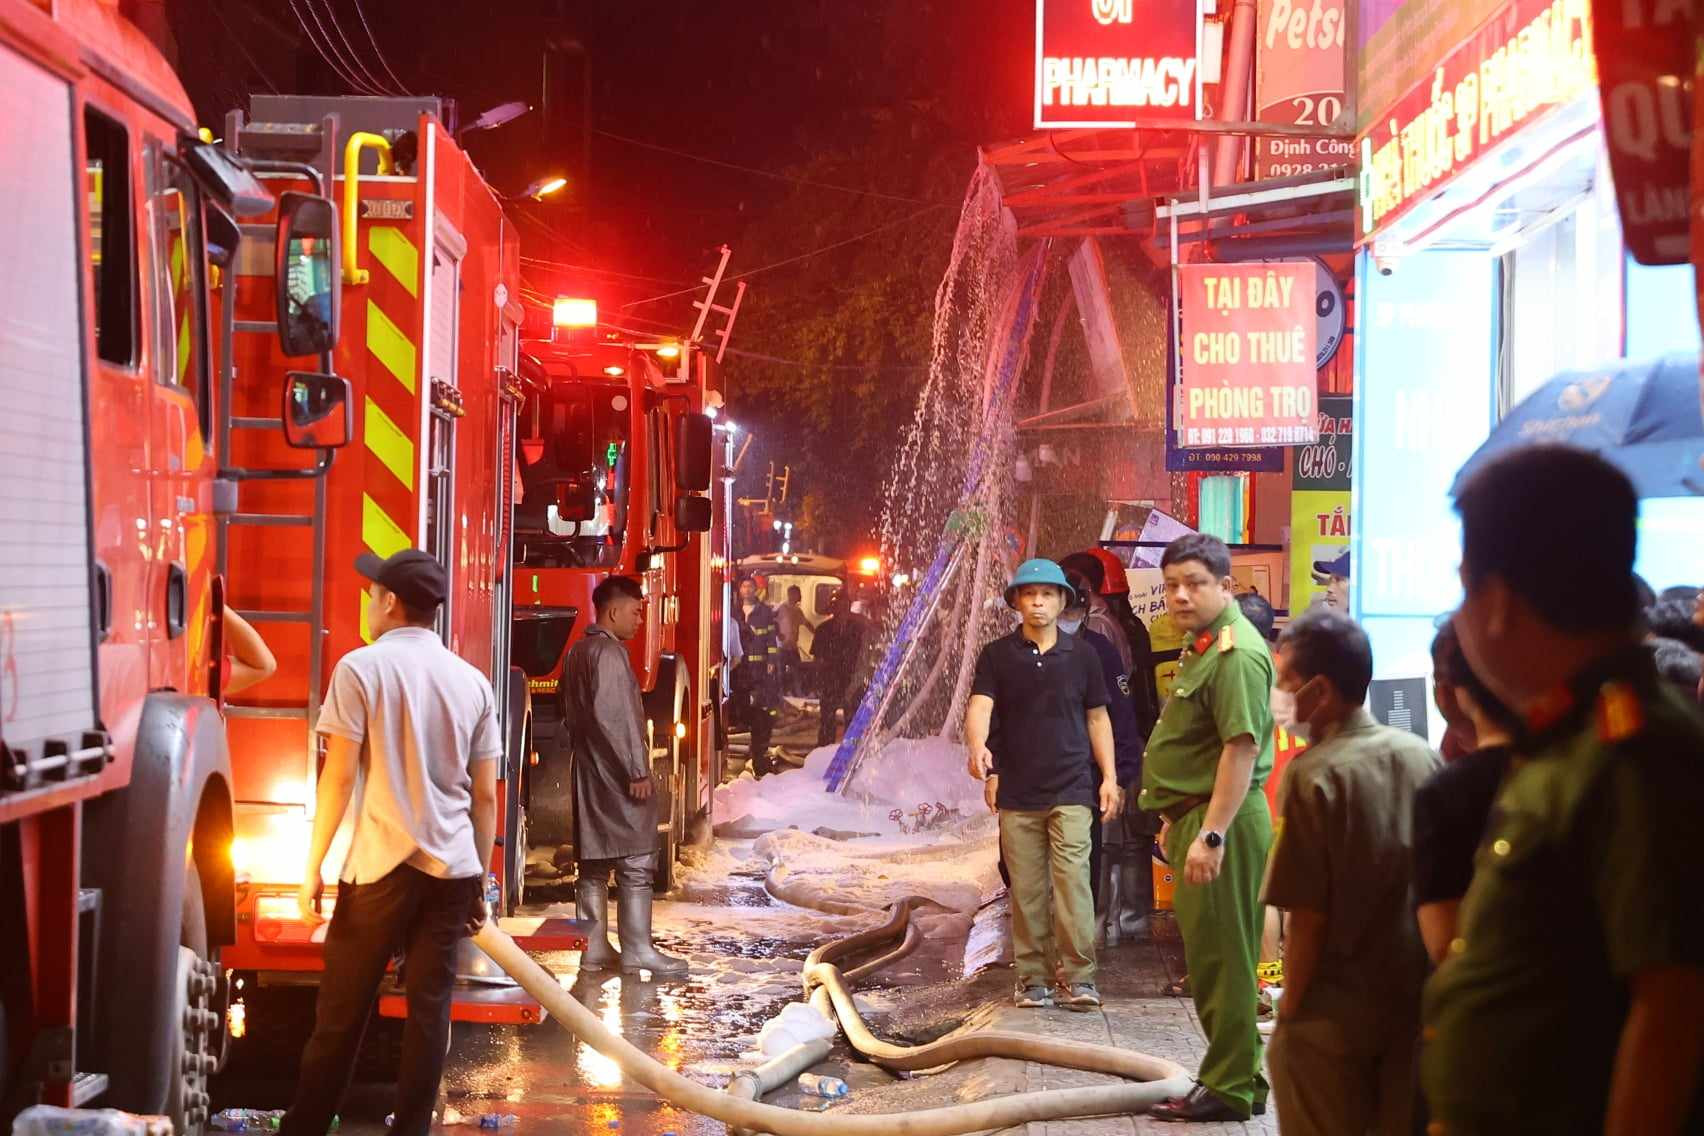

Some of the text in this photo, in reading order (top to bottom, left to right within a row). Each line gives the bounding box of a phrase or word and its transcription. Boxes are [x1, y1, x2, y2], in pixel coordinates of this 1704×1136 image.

[1042, 56, 1196, 107] PHARMACY
[1270, 139, 1311, 158] Định
[1204, 270, 1295, 317] TẠI ĐÂY
[1193, 331, 1241, 365] CHO
[1247, 325, 1306, 364] THUÊ
[1189, 380, 1312, 424] PHÒNG TRỌ
